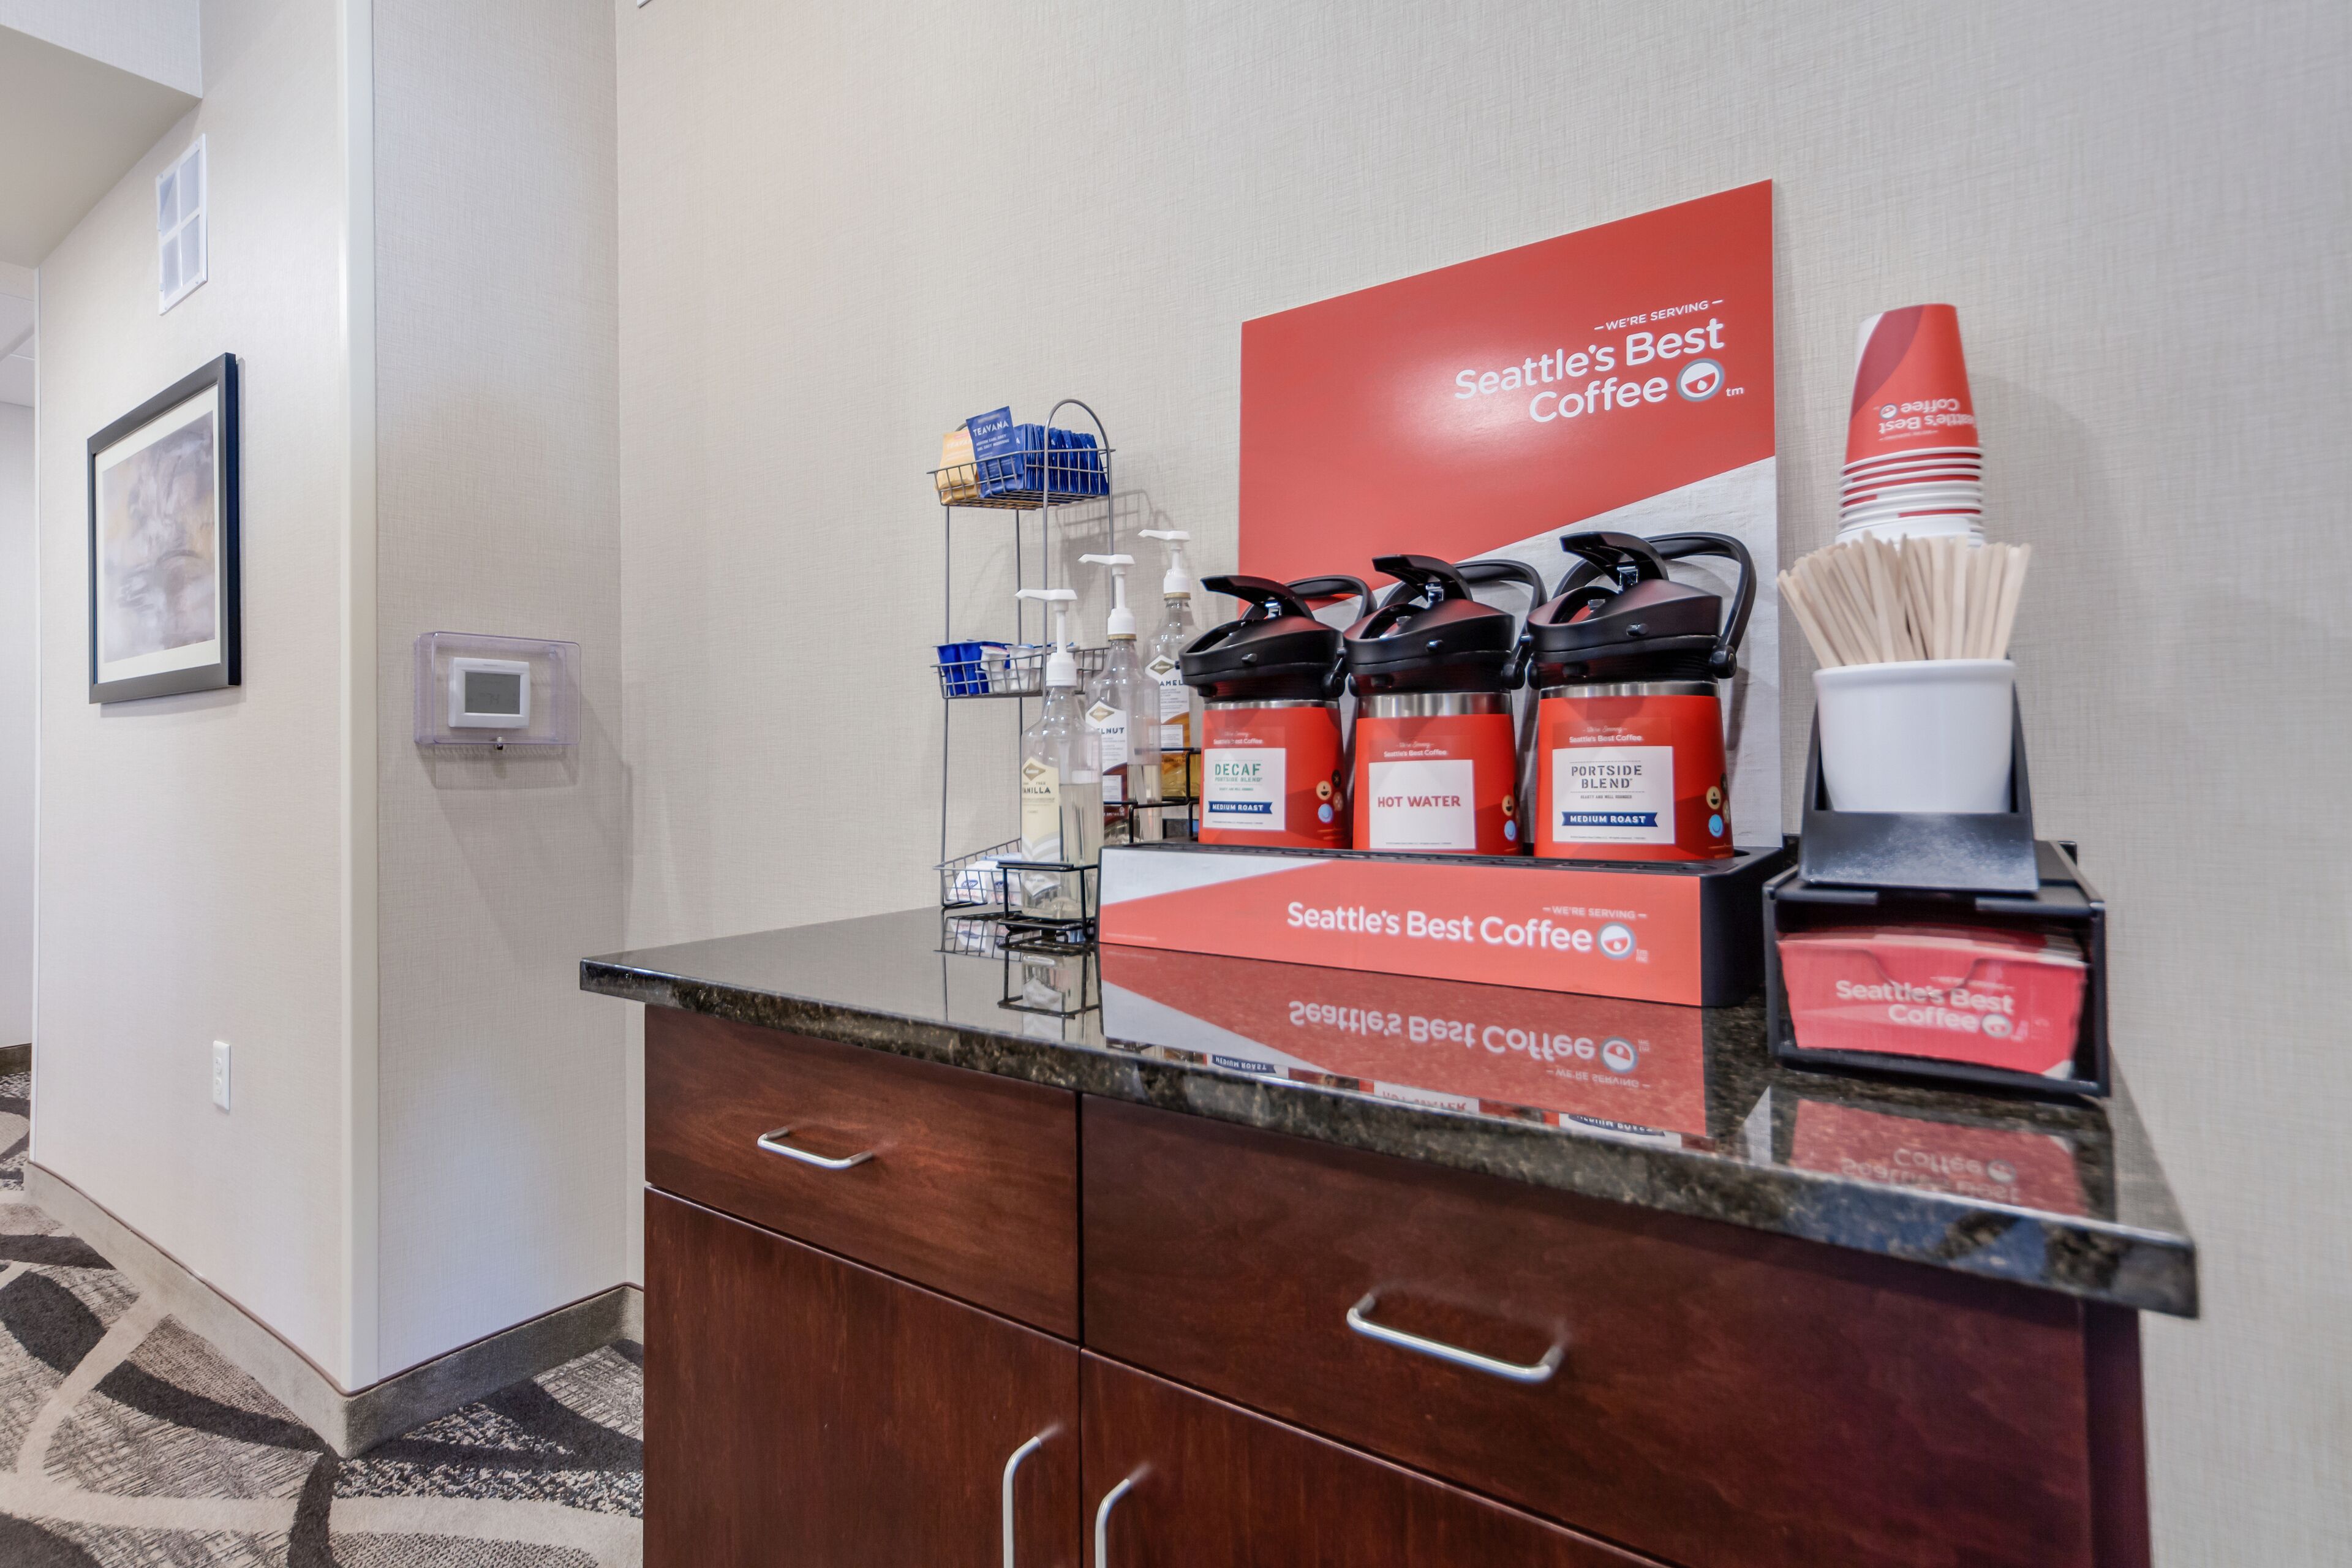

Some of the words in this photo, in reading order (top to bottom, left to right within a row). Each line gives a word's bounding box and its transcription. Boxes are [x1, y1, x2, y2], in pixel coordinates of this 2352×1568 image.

[1606, 314, 1646, 330] WE'RE
[1651, 301, 1708, 321] SERVING
[1454, 344, 1615, 400] Seattle's
[1626, 318, 1725, 366] Best
[1529, 376, 1669, 423] Coffee
[1900, 398, 1961, 413] Coffee
[973, 420, 1009, 437] TEAVANA
[1879, 417, 1921, 434] Best
[1215, 763, 1261, 775] DECAF
[1571, 765, 1642, 776] PORTSIDE
[1378, 796, 1403, 807] HOT
[1407, 795, 1461, 807] WATER
[1552, 906, 1585, 916] WE'RE
[1588, 908, 1636, 919] SERVING
[1287, 902, 1399, 935] Seattle's
[1407, 910, 1474, 943] Best
[1480, 916, 1592, 952] Coffee
[1835, 979, 1945, 1004] Seattle's
[1950, 988, 2015, 1015] Best
[1888, 1004, 1980, 1033] Coffee
